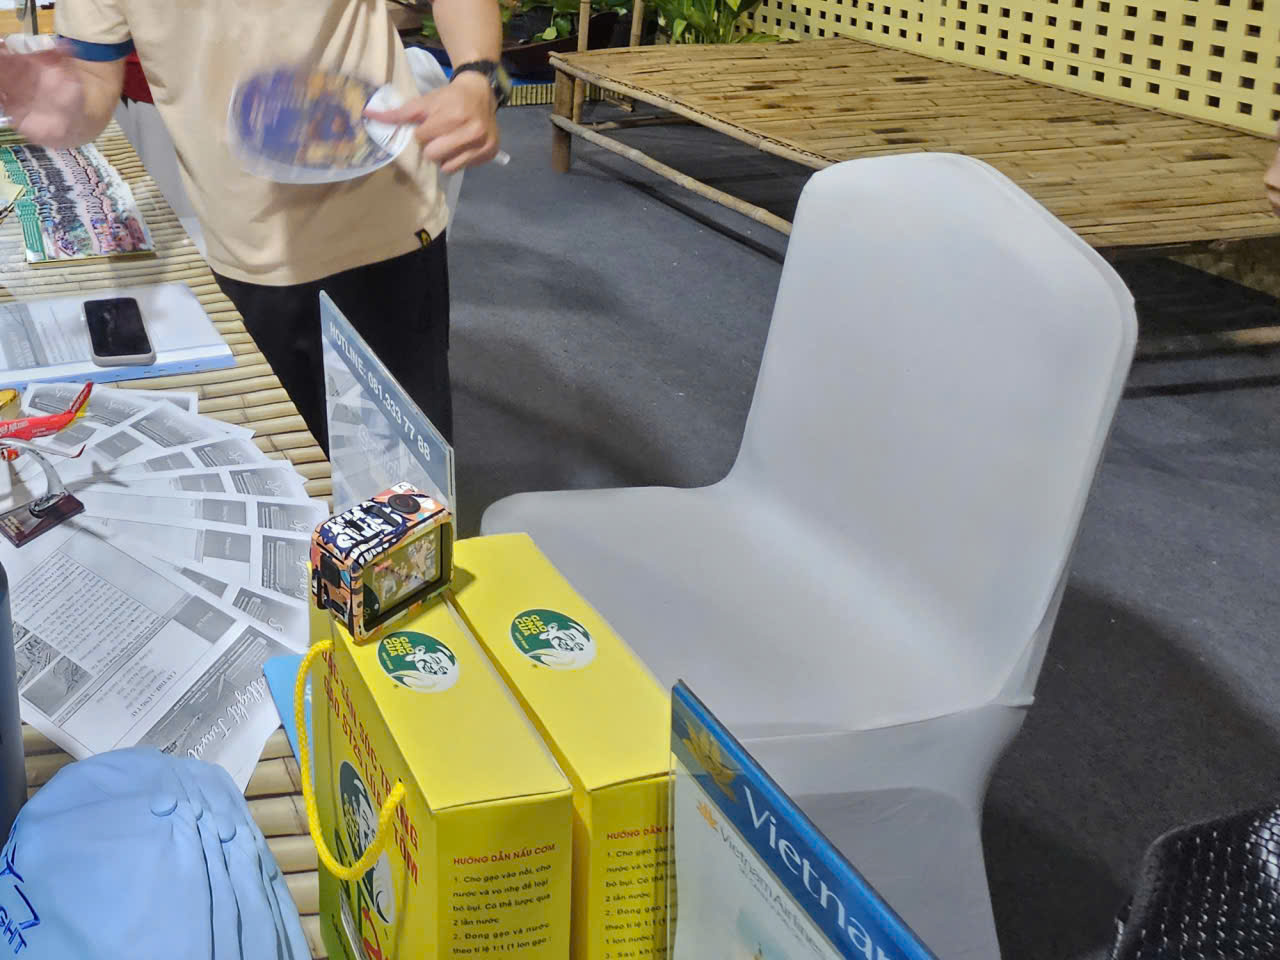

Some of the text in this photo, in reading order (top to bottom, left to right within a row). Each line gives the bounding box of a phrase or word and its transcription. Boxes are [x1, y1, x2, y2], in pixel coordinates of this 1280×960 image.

[329, 321, 431, 462] HOTLINE: 081.333 77 88
[744, 785, 892, 960] Vietna
